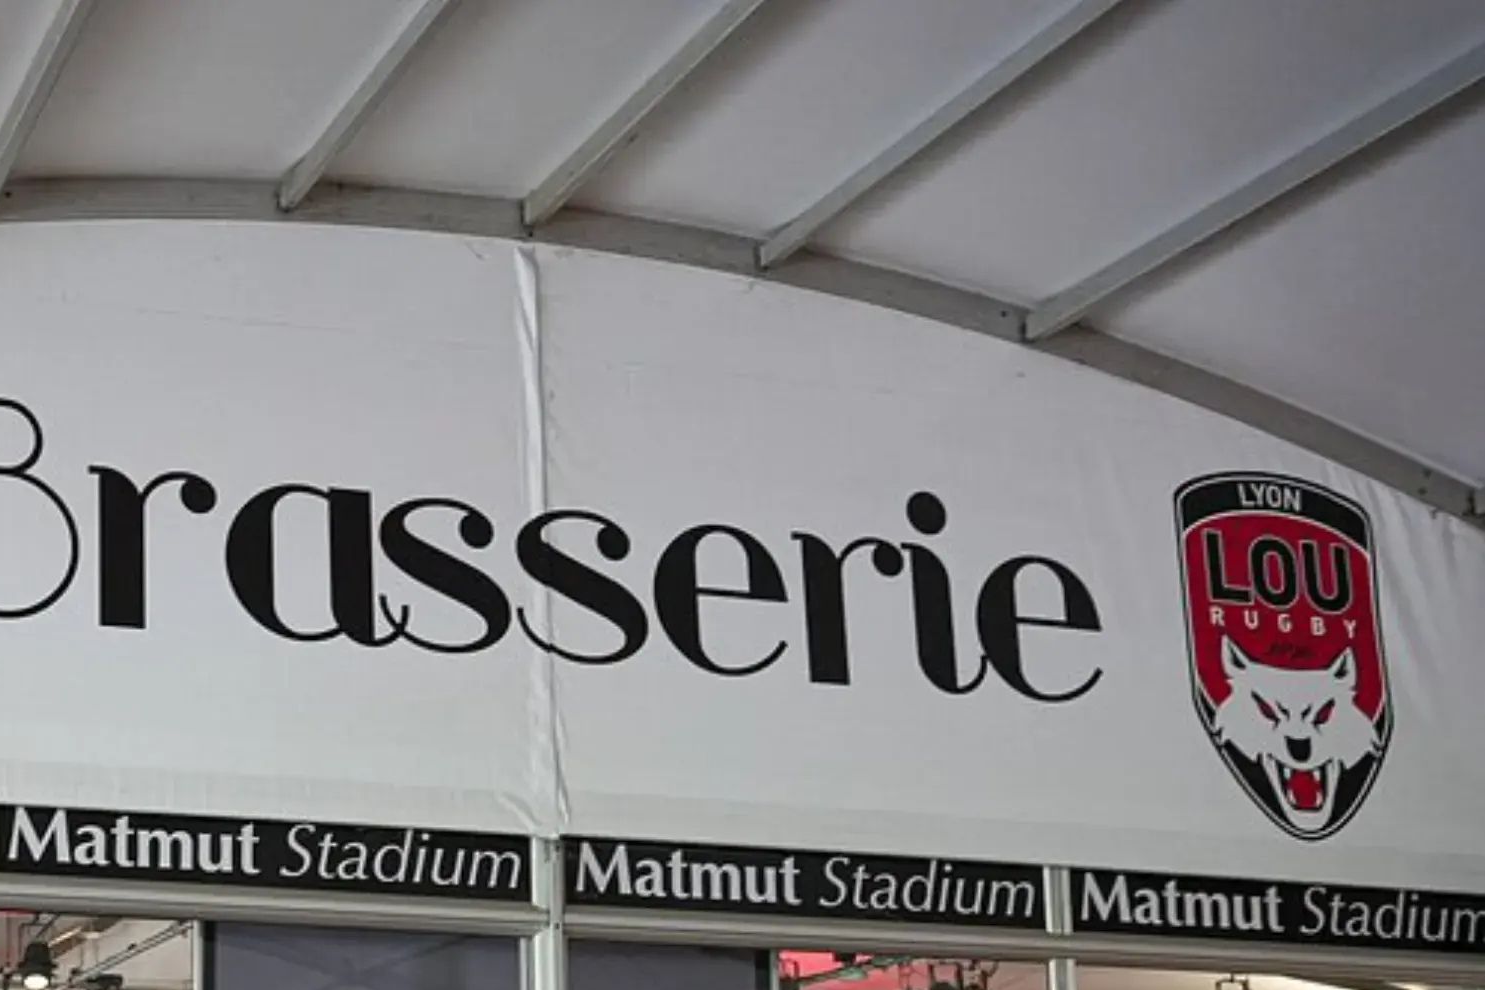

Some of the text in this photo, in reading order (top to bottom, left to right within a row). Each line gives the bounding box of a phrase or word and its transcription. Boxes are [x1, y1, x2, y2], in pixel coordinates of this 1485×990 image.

[1237, 483, 1301, 511] LYON
[1203, 529, 1353, 613] LOU
[7, 805, 523, 889] Matmut Stadium
[576, 841, 1036, 918] Matmut Stadium
[1081, 871, 1286, 933] Matmut
